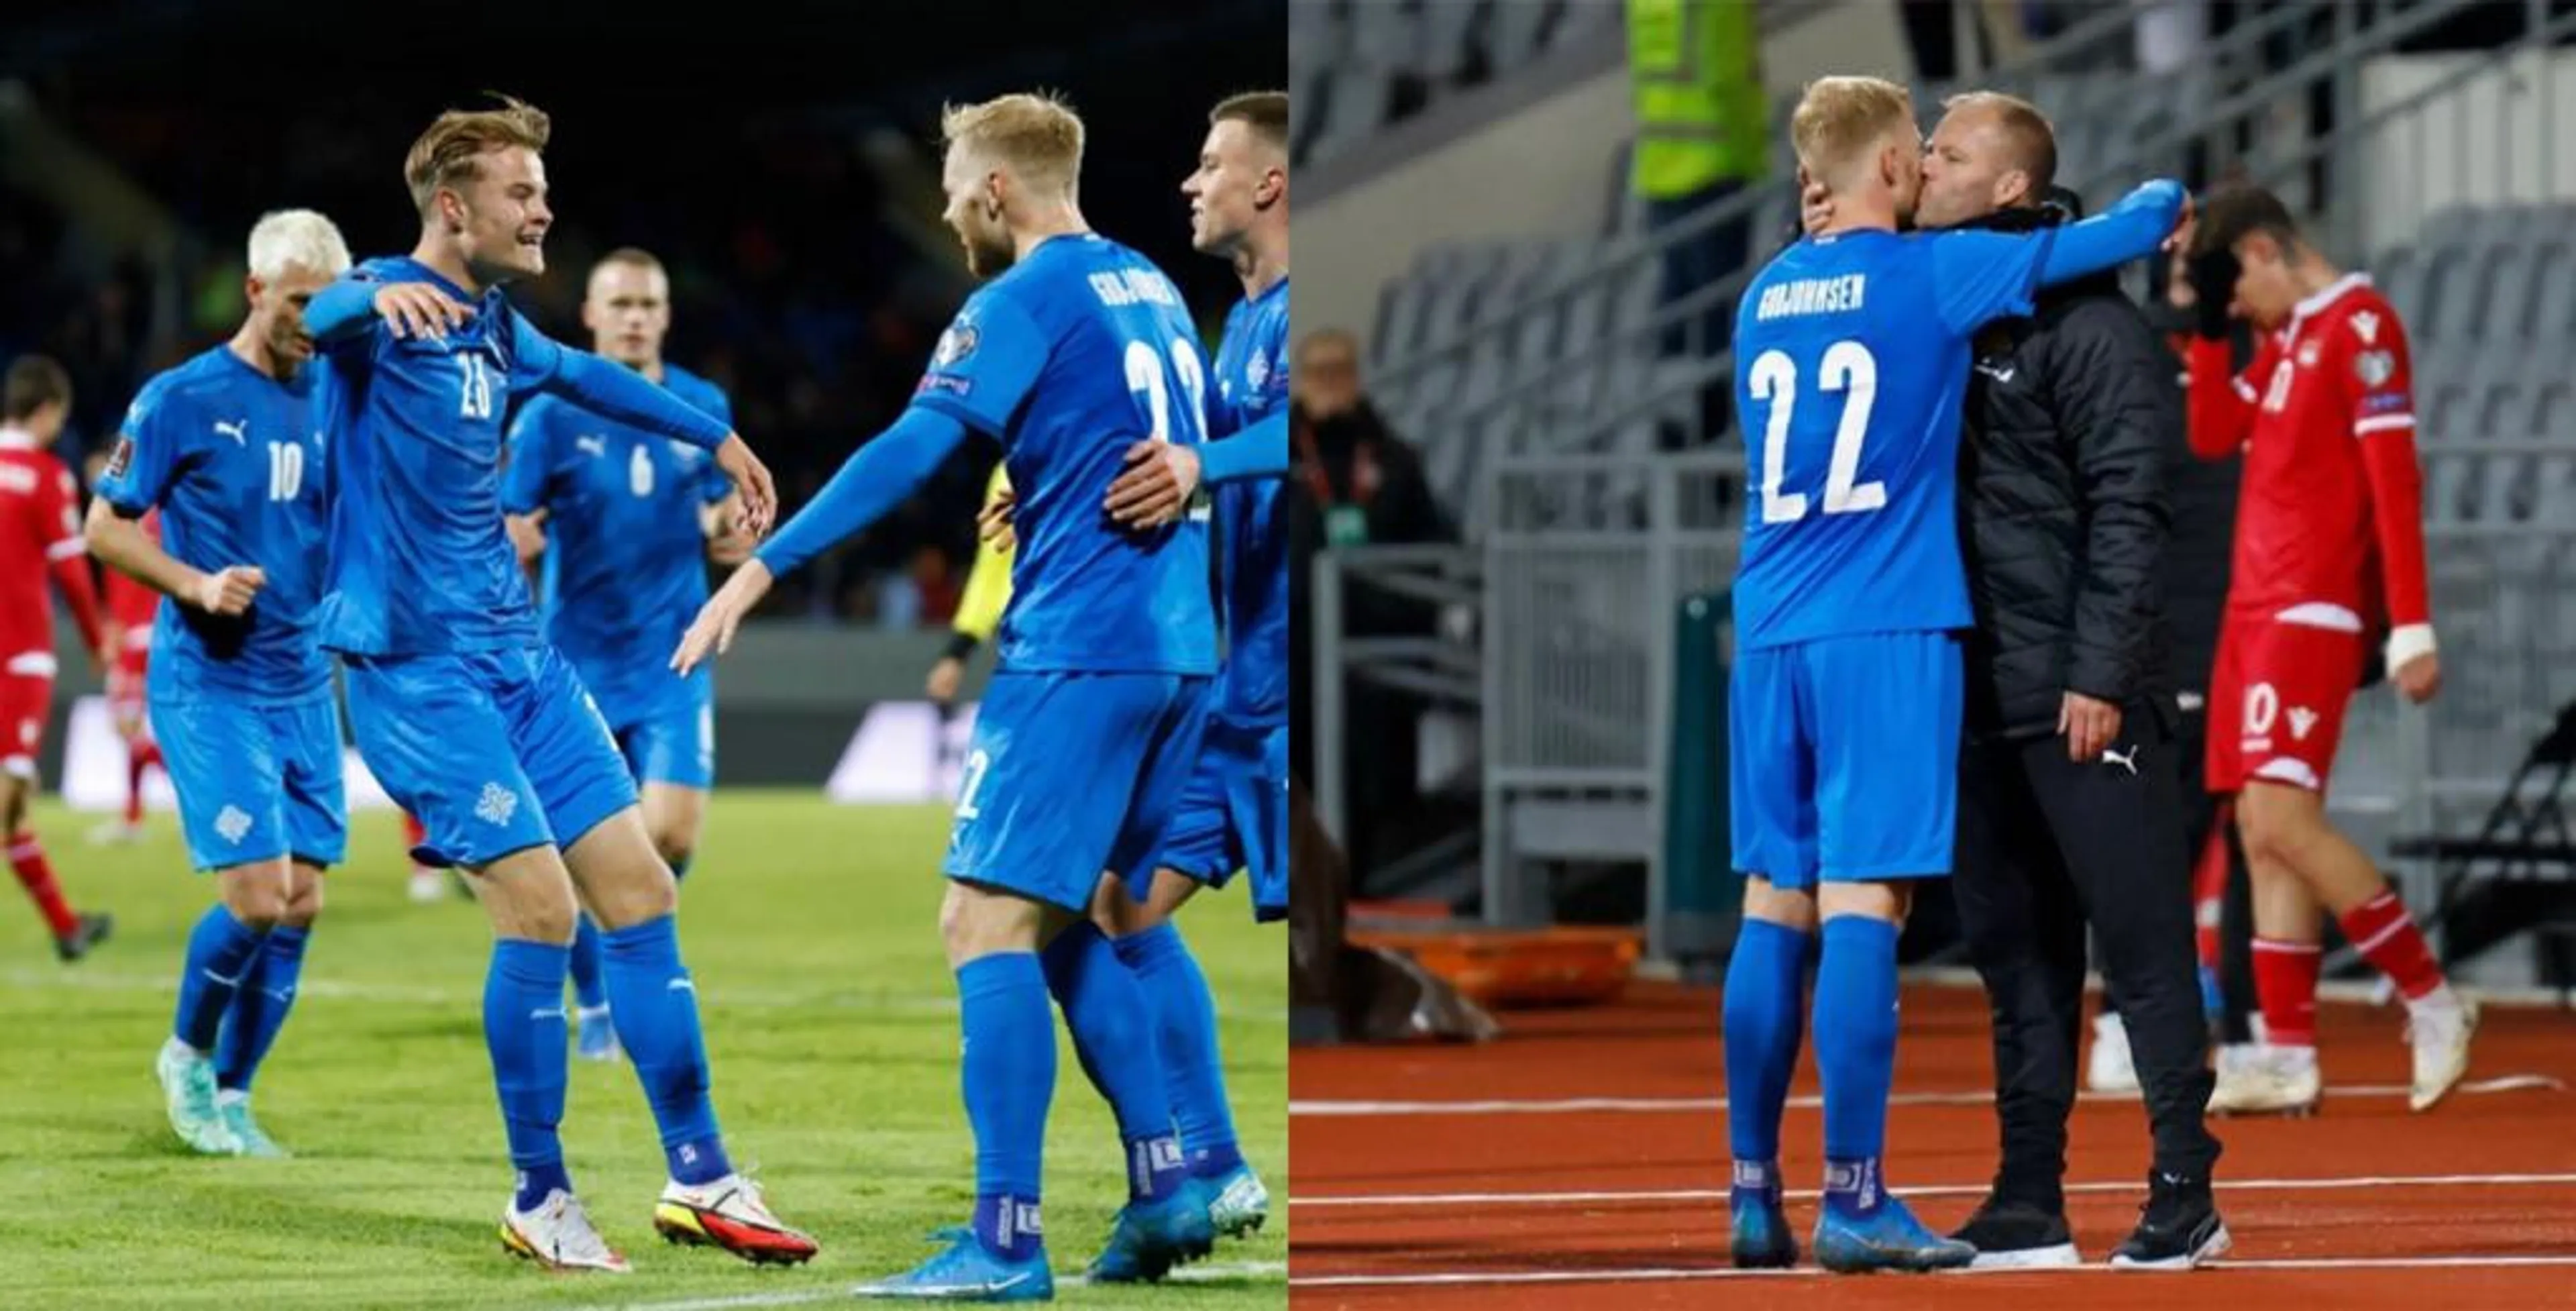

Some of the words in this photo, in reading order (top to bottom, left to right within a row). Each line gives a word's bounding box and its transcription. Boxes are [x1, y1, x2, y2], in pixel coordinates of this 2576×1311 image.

[1749, 339, 1887, 524] 22
[267, 440, 303, 501] 10
[629, 443, 655, 496] 6
